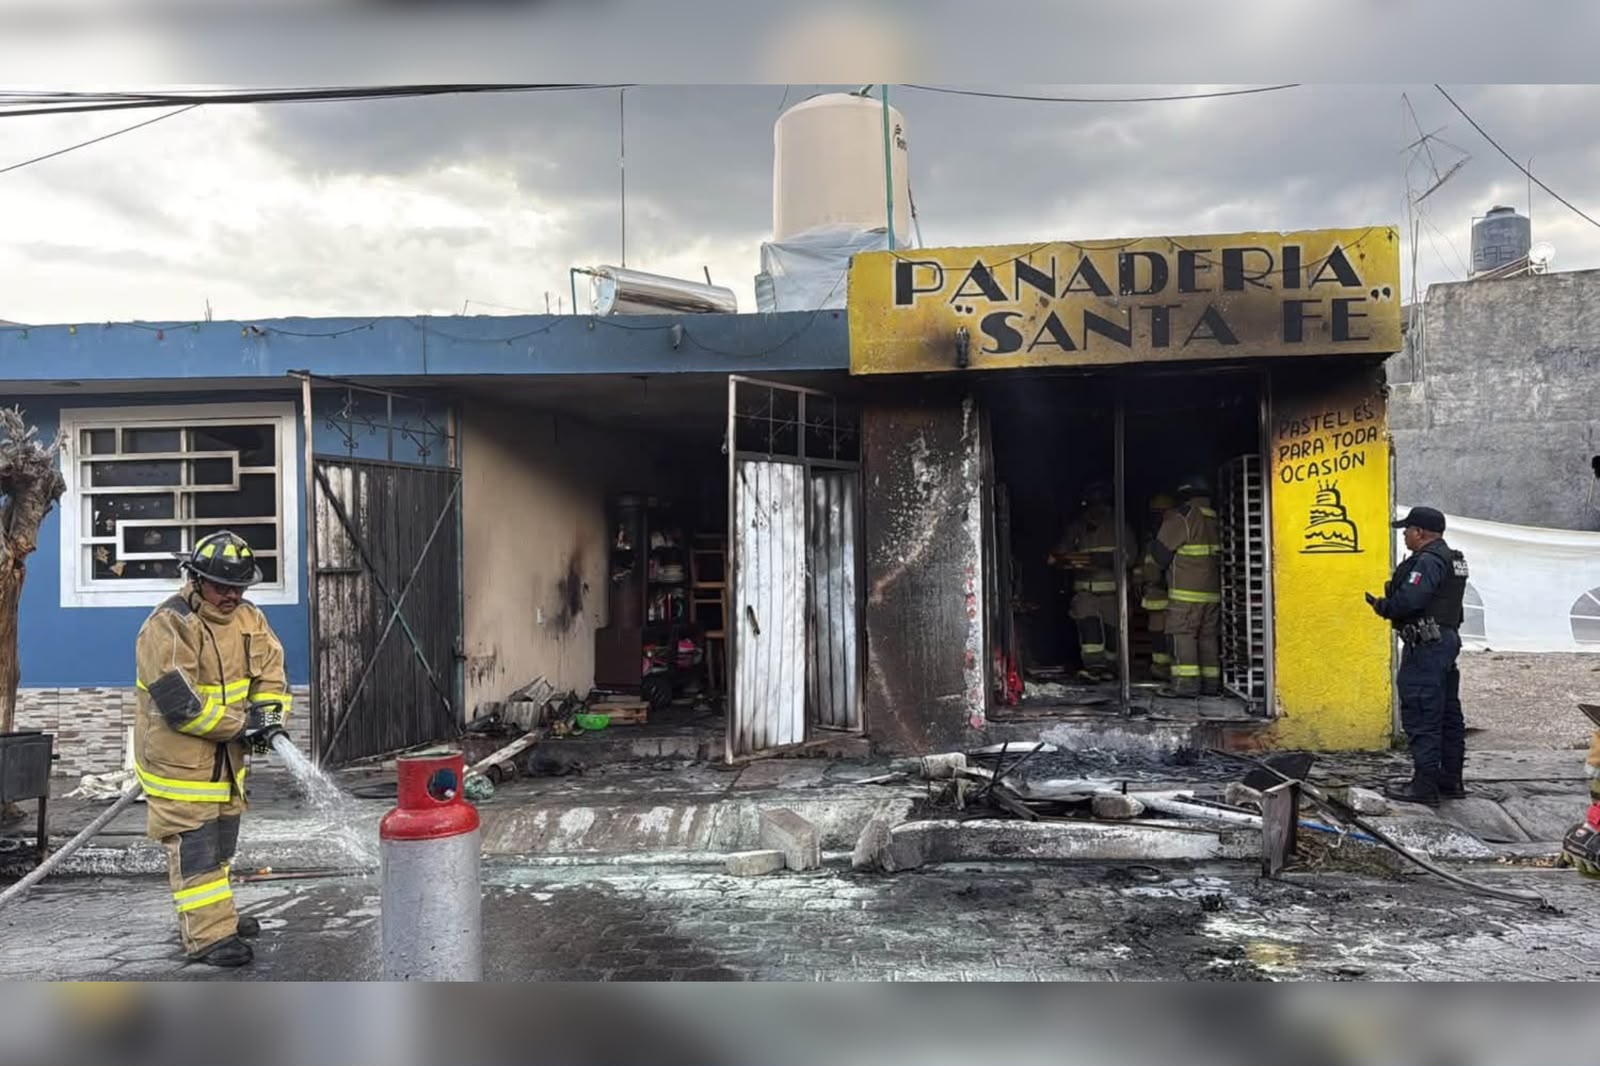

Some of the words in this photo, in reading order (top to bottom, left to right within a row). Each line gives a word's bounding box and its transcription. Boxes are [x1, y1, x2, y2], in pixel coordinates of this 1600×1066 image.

[896, 245, 1362, 305] PANADERIA
[1280, 438, 1324, 462] PARA
[1332, 426, 1377, 450] TODA
[1281, 451, 1365, 483] OCASIÓN
